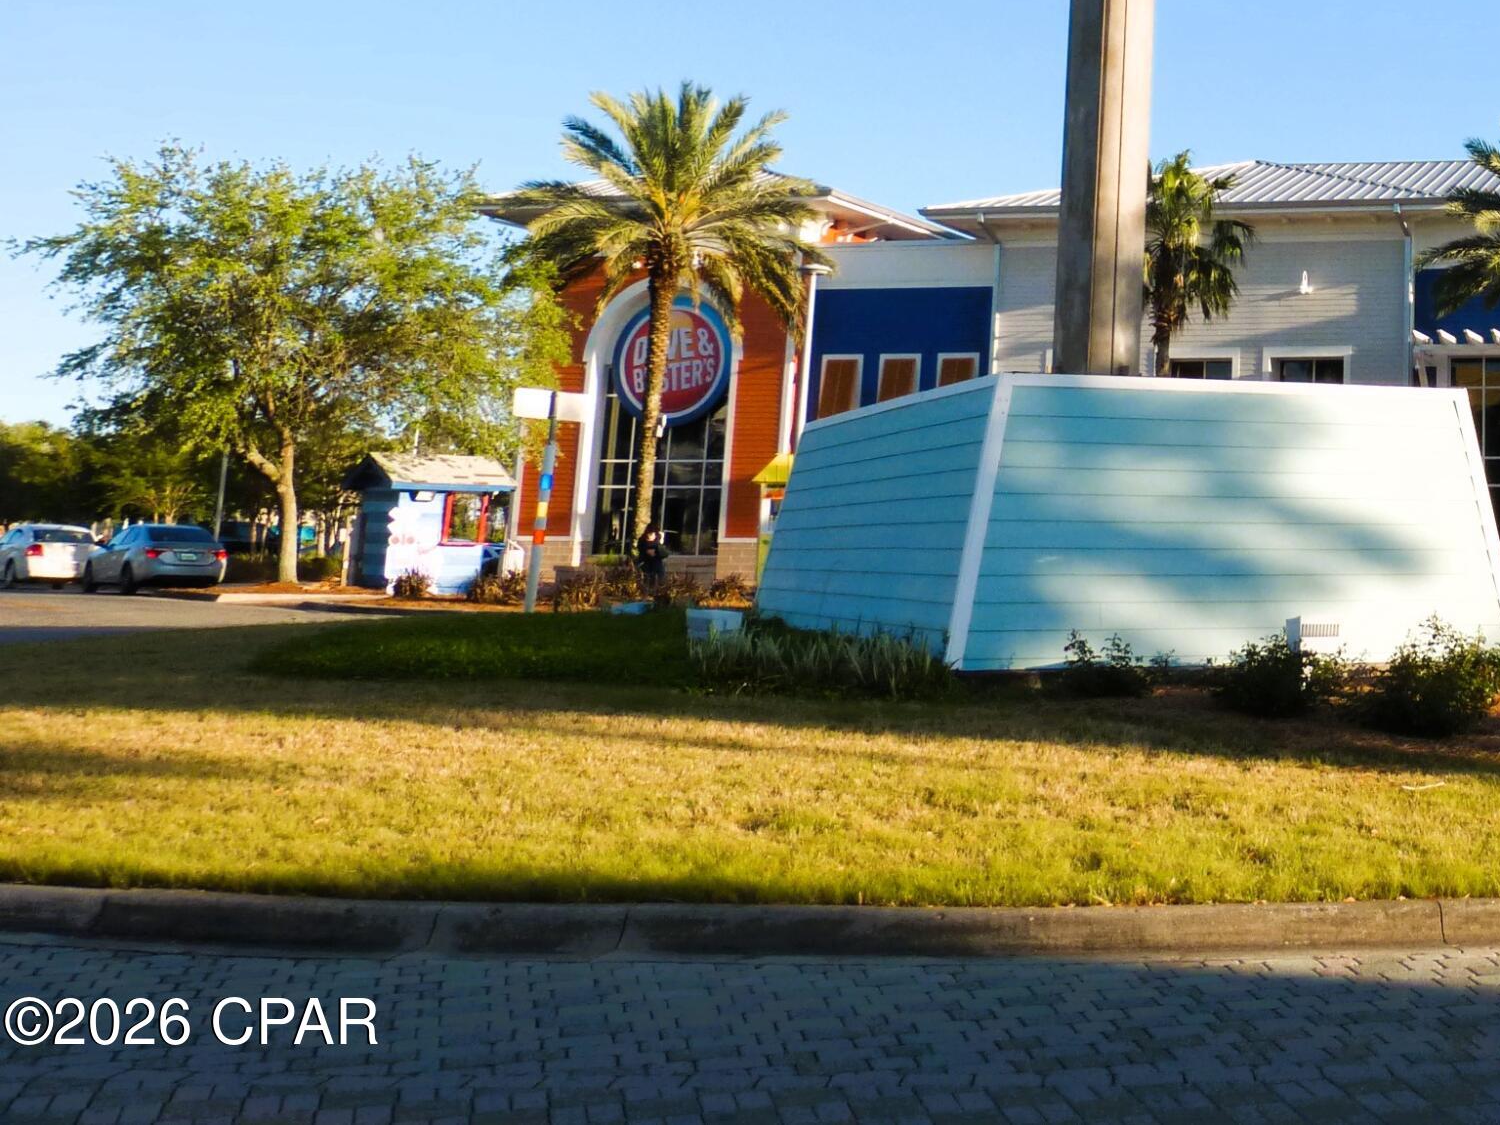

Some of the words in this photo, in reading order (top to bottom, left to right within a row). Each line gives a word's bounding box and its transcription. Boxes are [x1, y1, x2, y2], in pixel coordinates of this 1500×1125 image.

[633, 327, 694, 366] DVE
[696, 327, 714, 357] &
[633, 357, 716, 393] BSTER'S
